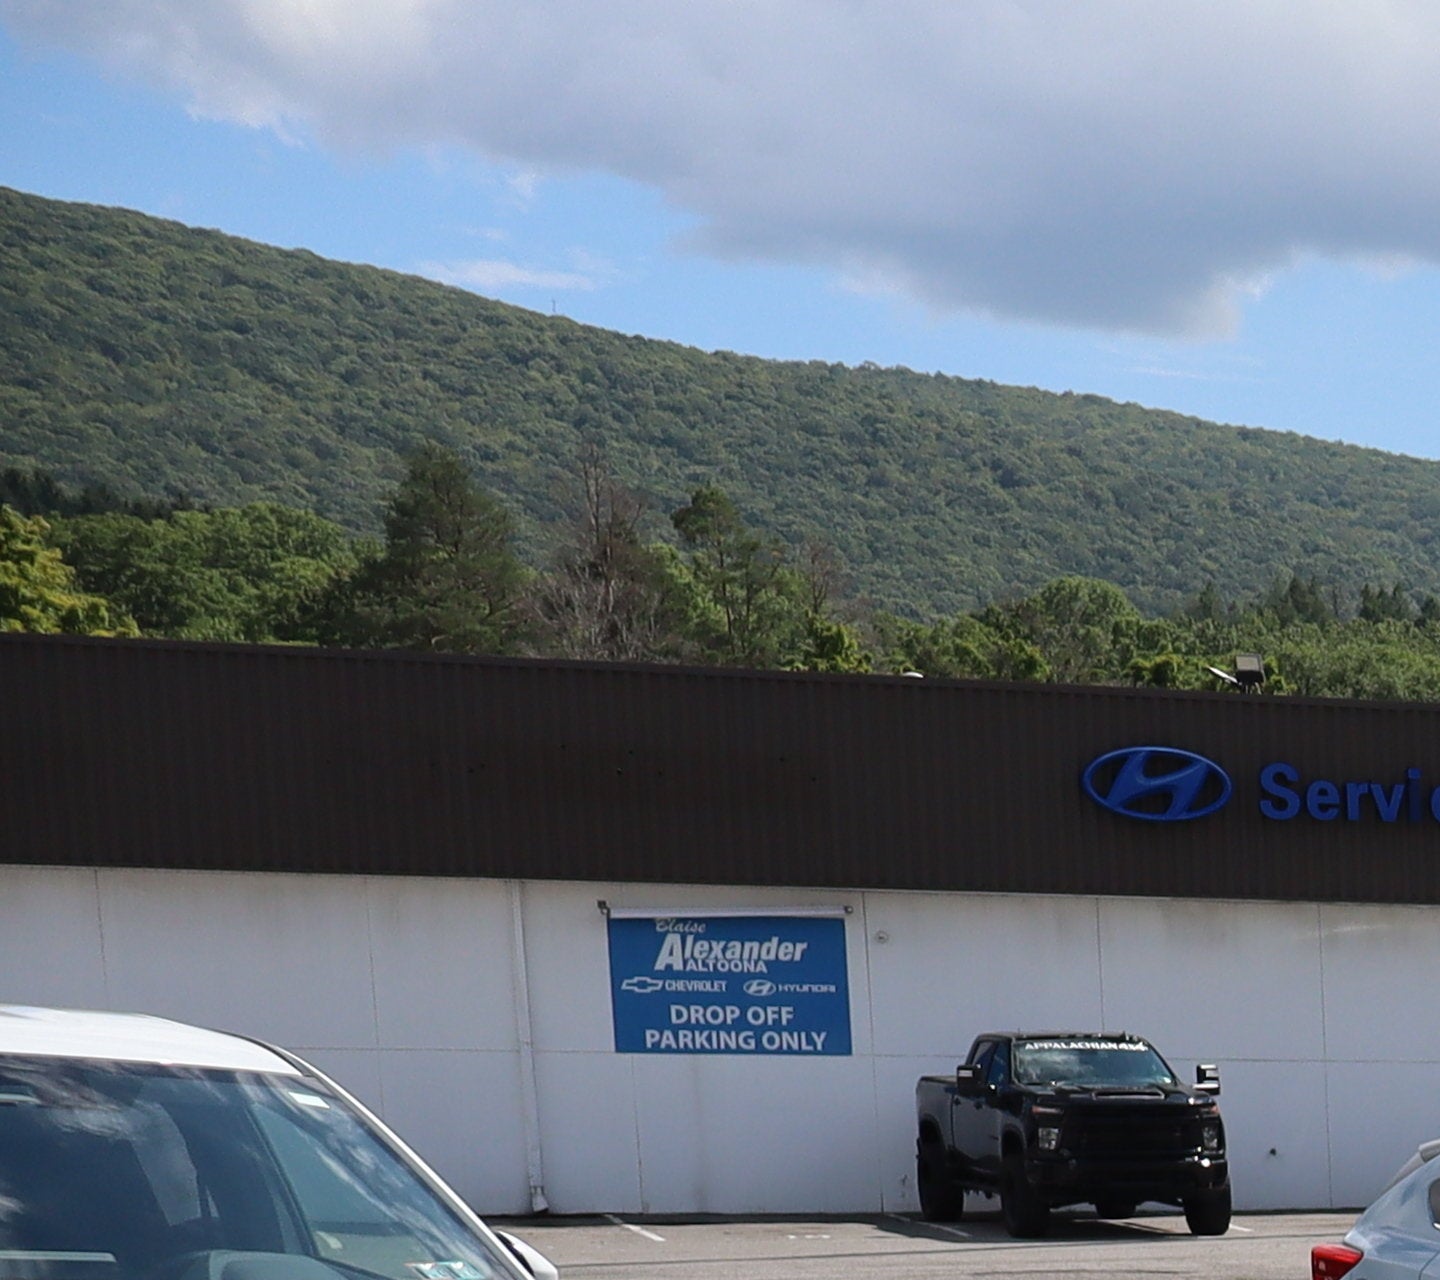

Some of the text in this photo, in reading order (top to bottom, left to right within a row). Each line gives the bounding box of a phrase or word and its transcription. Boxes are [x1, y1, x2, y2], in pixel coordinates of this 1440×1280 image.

[655, 918, 707, 933] Blaise
[654, 933, 808, 971] Alexander
[686, 960, 768, 973] ALTOONA
[665, 979, 727, 992] CHEVROLET
[778, 983, 836, 993] HYUNDAI
[670, 1005, 794, 1026] DROP OFF
[645, 1030, 827, 1051] PARKING ONLY
